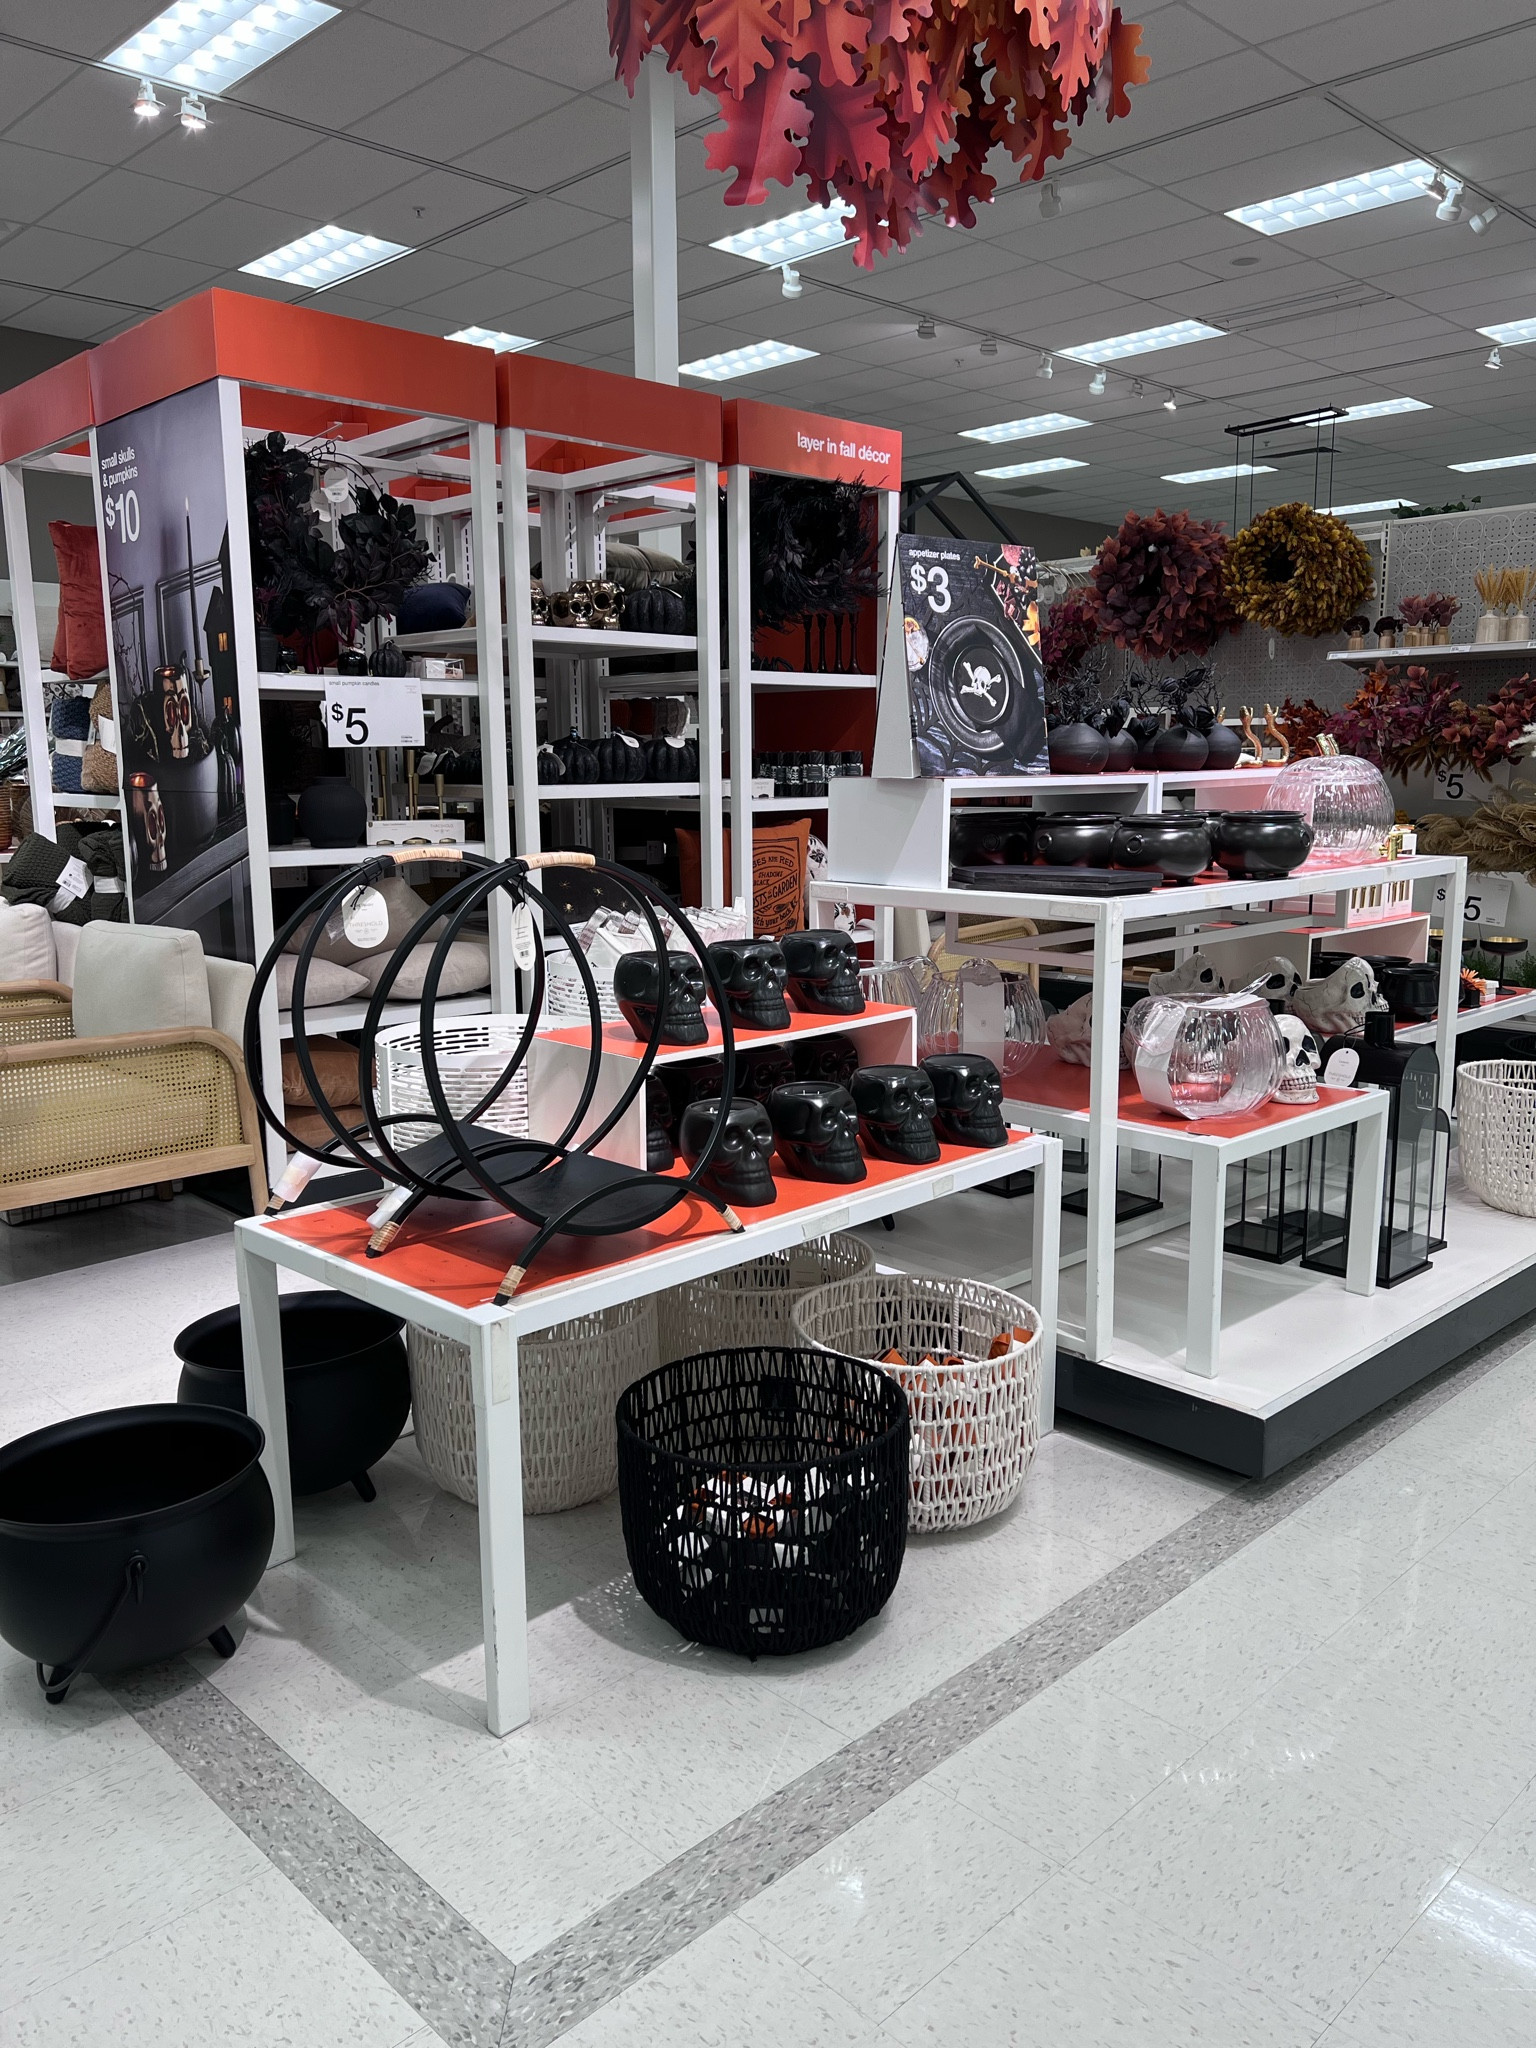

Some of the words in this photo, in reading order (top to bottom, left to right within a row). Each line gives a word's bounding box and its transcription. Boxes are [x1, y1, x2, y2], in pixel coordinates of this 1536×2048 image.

[102, 452, 118, 470] small
[118, 447, 135, 464] skulls
[797, 431, 825, 453] layer
[826, 437, 837, 454] in
[839, 440, 856, 458] fall
[858, 445, 891, 464] décor
[103, 474, 108, 487] &
[109, 465, 138, 488] pumpkins
[105, 489, 140, 544] $10
[908, 549, 940, 559] appetizer
[940, 550, 961, 561] plates
[910, 561, 952, 614] $3
[331, 701, 369, 746] $5
[1437, 769, 1464, 800] $5
[779, 856, 794, 868] RED
[753, 891, 768, 909] STS
[772, 873, 798, 898] GARDEN
[765, 916, 779, 928] your
